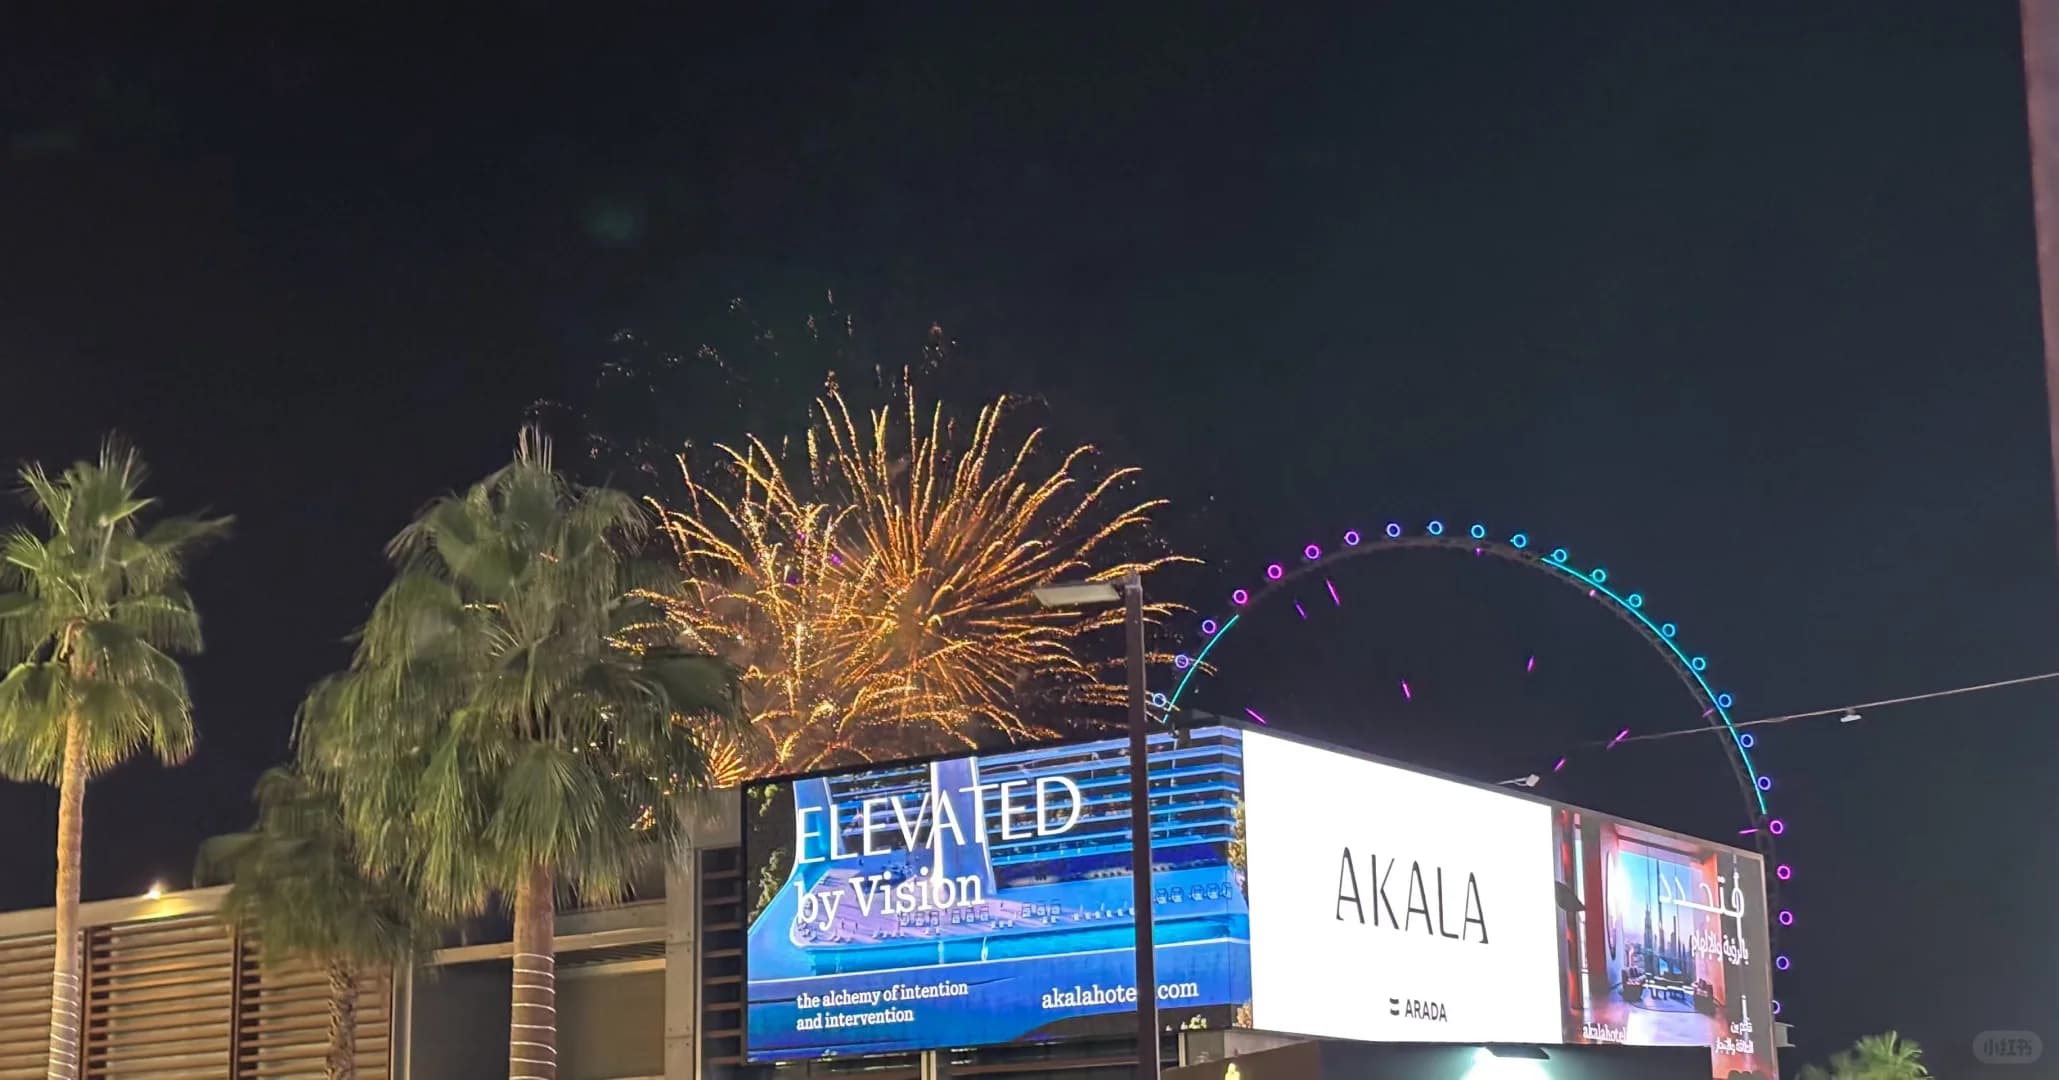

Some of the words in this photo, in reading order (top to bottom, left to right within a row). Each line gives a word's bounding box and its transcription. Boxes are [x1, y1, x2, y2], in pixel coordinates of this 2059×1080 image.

[797, 775, 1081, 864] ELEVATED
[794, 881, 844, 930] by
[849, 866, 984, 917] Vision
[1336, 846, 1489, 944] AKALA
[797, 993, 821, 1009] the
[822, 989, 881, 1006] alchemy
[883, 985, 900, 1002] of
[901, 980, 968, 1000] intention
[1405, 998, 1448, 1023] ARADA
[796, 1013, 823, 1031] and
[825, 1007, 914, 1028] intervention
